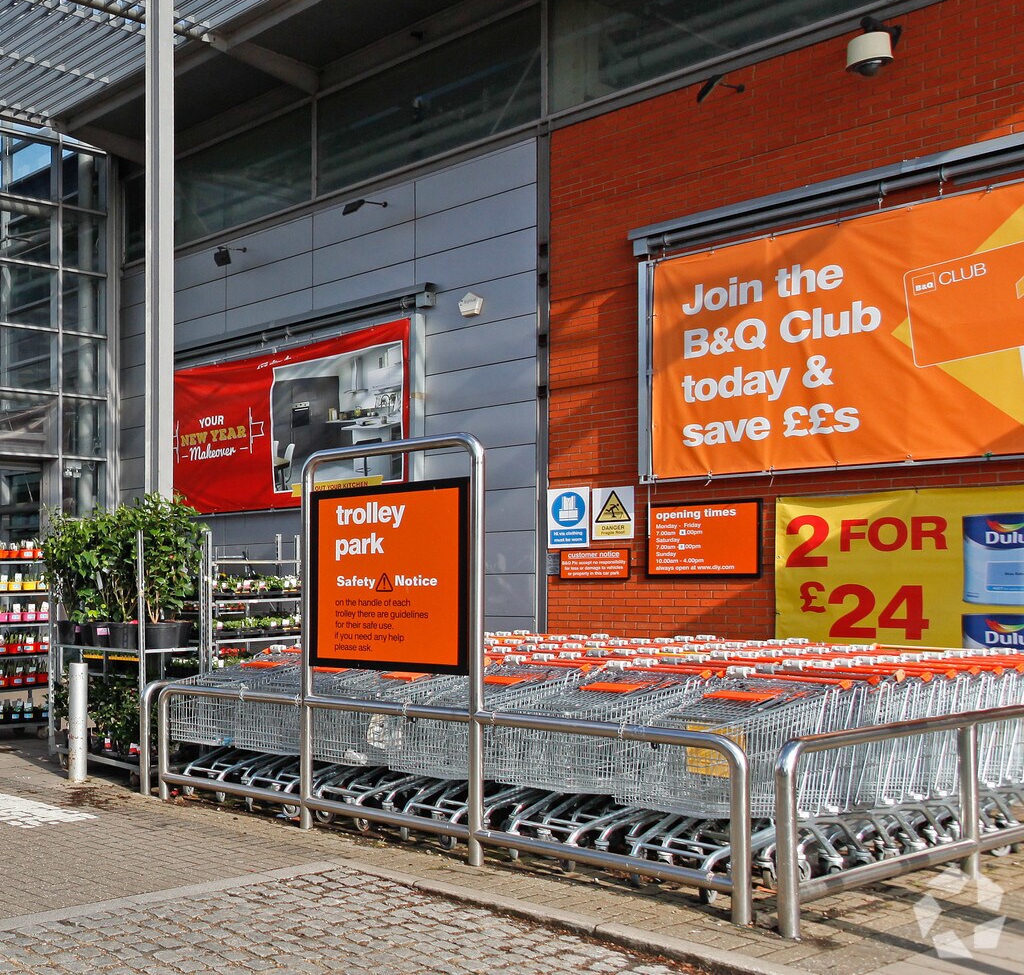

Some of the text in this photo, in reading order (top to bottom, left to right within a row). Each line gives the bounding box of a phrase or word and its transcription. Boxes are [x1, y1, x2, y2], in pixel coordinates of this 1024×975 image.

[915, 262, 987, 292] B&Q CLUB
[681, 263, 844, 316] Join the
[683, 300, 882, 360] B&Q Club
[681, 354, 834, 403] today &
[199, 415, 224, 429] YOUR
[682, 403, 860, 447] save ££s
[180, 425, 247, 447] NEW YEAR
[189, 443, 236, 461] Makeover
[343, 481, 369, 489] KITCHEN
[336, 501, 406, 528] trolley
[656, 508, 736, 521] opening times
[335, 532, 385, 561] park
[785, 514, 948, 568] 2 FOR
[599, 550, 620, 558] notice
[336, 574, 438, 589] Safety Notice
[345, 598, 357, 606] the
[358, 598, 382, 607] handle
[384, 598, 392, 607] of
[392, 598, 410, 607] each
[799, 581, 929, 641] £24
[335, 610, 356, 619] trolley
[357, 610, 376, 618] there
[390, 610, 429, 620] guidelines
[346, 621, 361, 629] their
[362, 621, 378, 629] safe
[340, 633, 353, 641] you
[354, 632, 372, 640] need
[374, 634, 387, 643] any
[388, 633, 405, 643] help
[334, 643, 373, 652] please ask.
